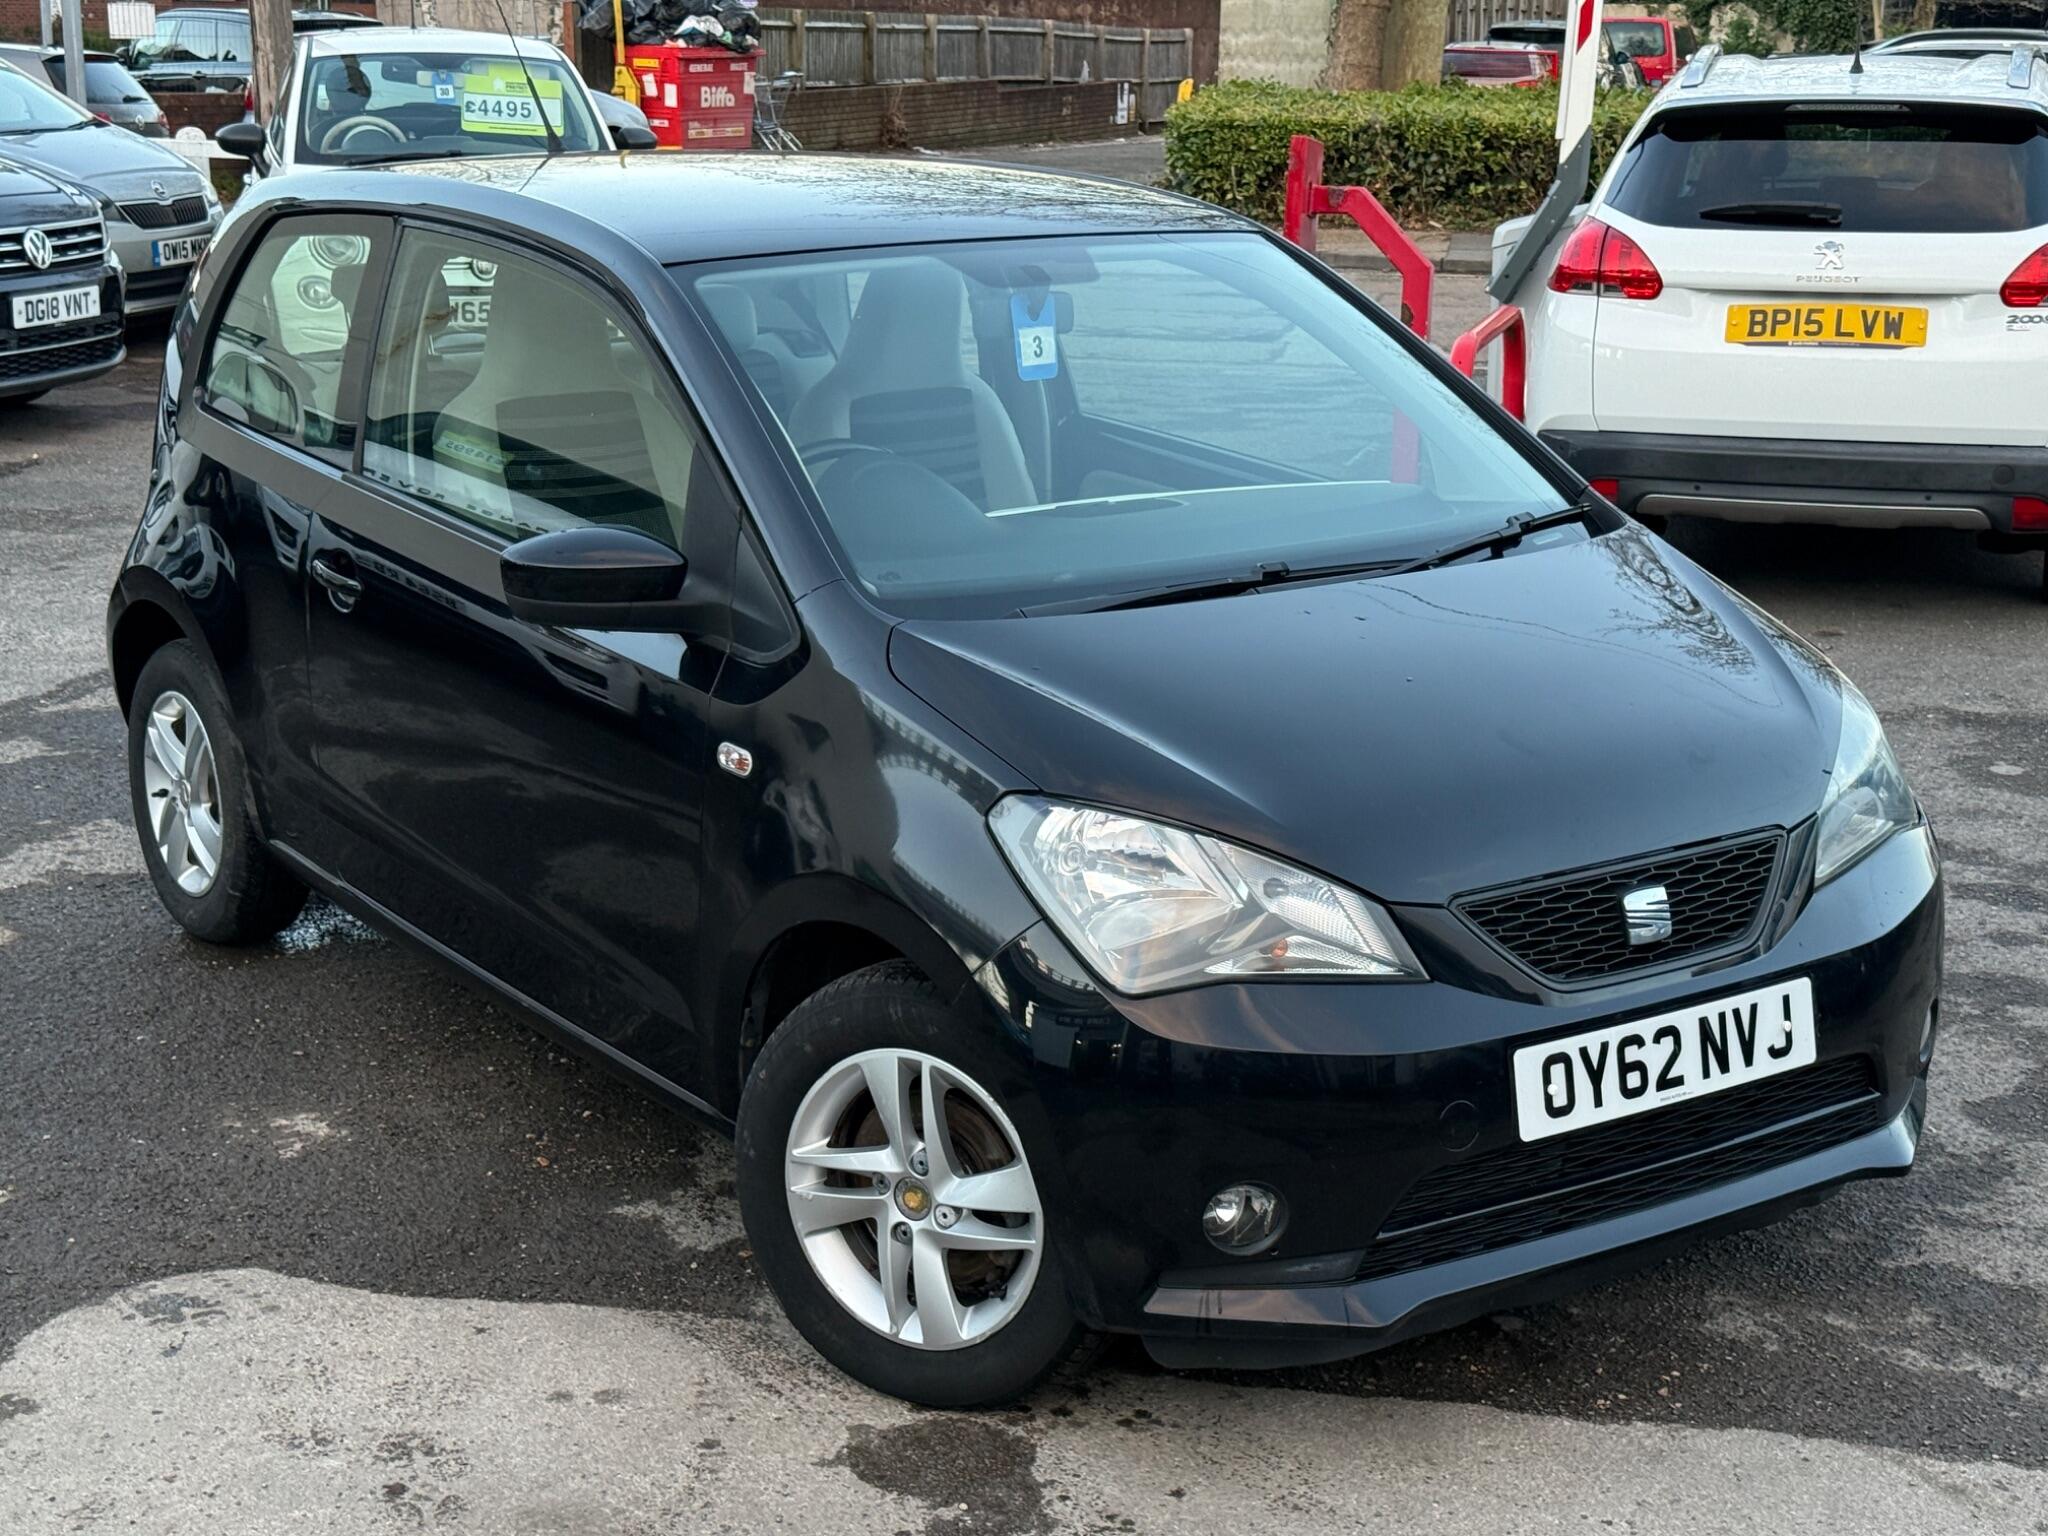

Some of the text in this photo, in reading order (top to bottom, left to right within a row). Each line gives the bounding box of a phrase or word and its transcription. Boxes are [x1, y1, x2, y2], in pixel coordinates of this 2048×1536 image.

[440, 87, 450, 97] 30
[700, 86, 735, 108] Biffa
[465, 99, 531, 119] £4495
[25, 292, 91, 323] DG18 VNT
[1747, 308, 1904, 339] BP15 LVW
[1033, 335, 1043, 358] 3
[1542, 994, 1793, 1119] OY62 NVJ
